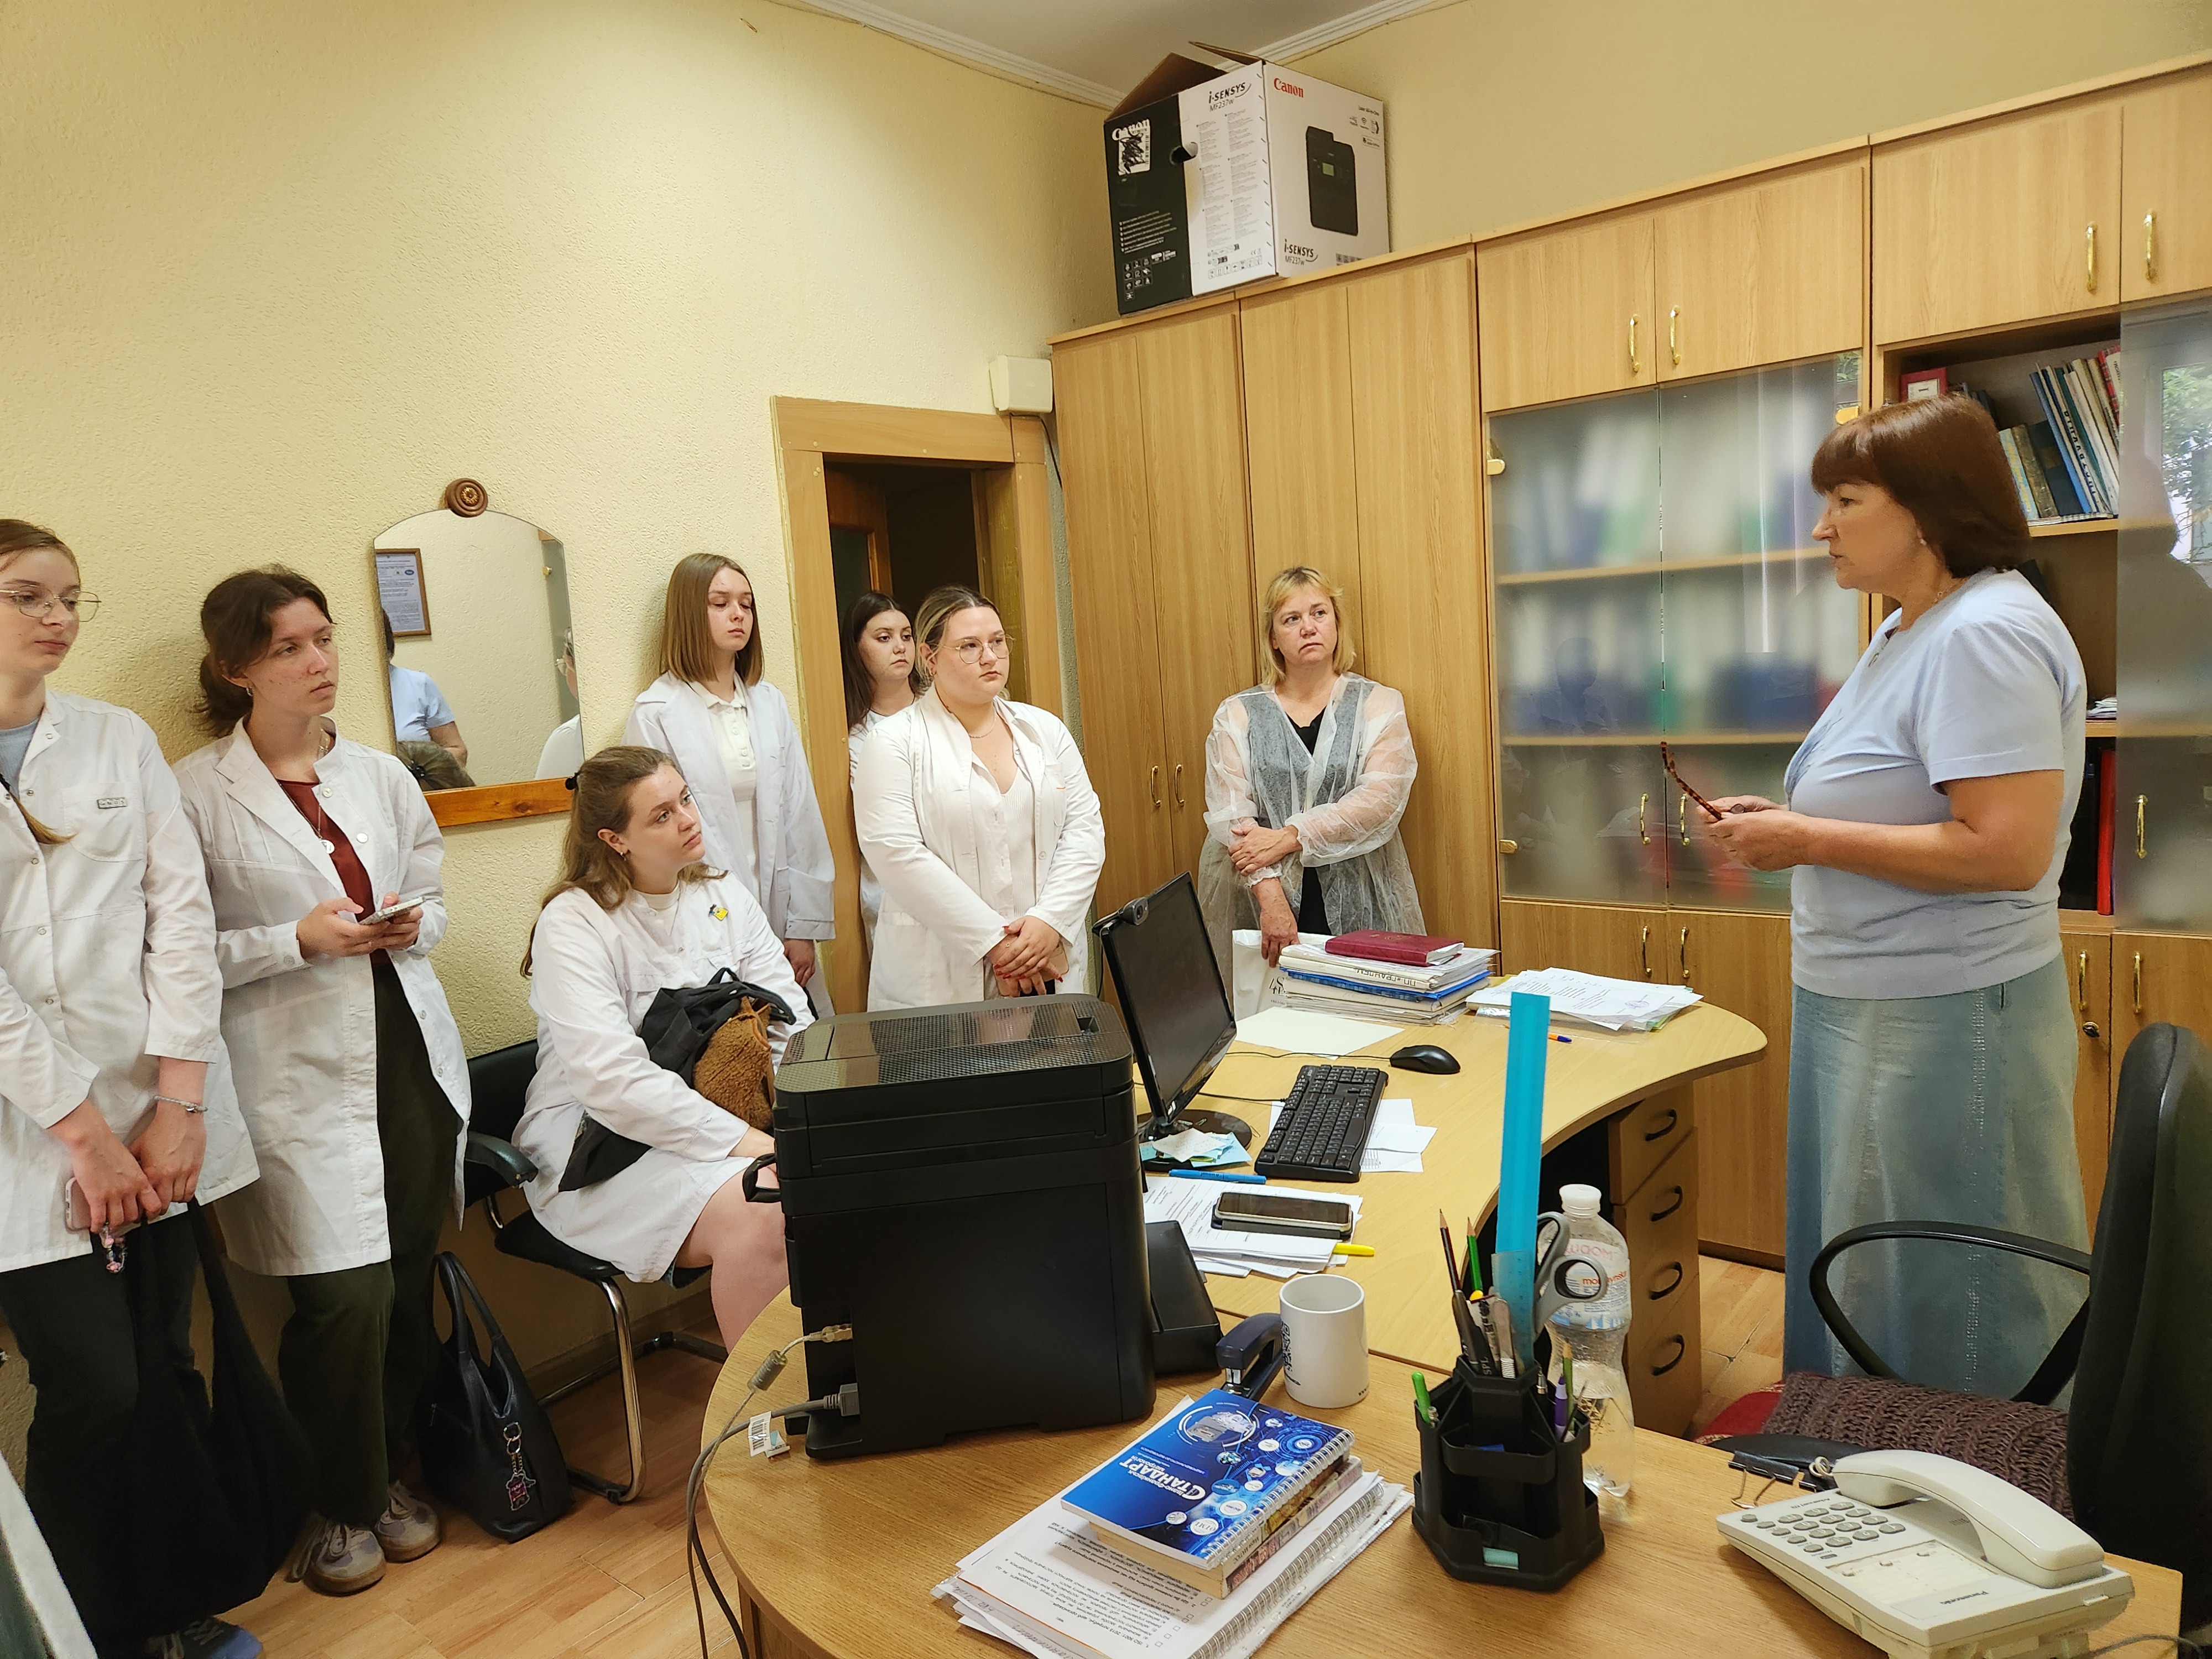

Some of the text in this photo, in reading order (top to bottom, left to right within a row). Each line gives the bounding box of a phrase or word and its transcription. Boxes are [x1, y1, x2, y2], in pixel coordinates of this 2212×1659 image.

[1274, 77, 1304, 98] Canon
[1118, 1458, 1205, 1500] СТАНДАРТ
[1939, 1590, 1989, 1604] Panasonic
